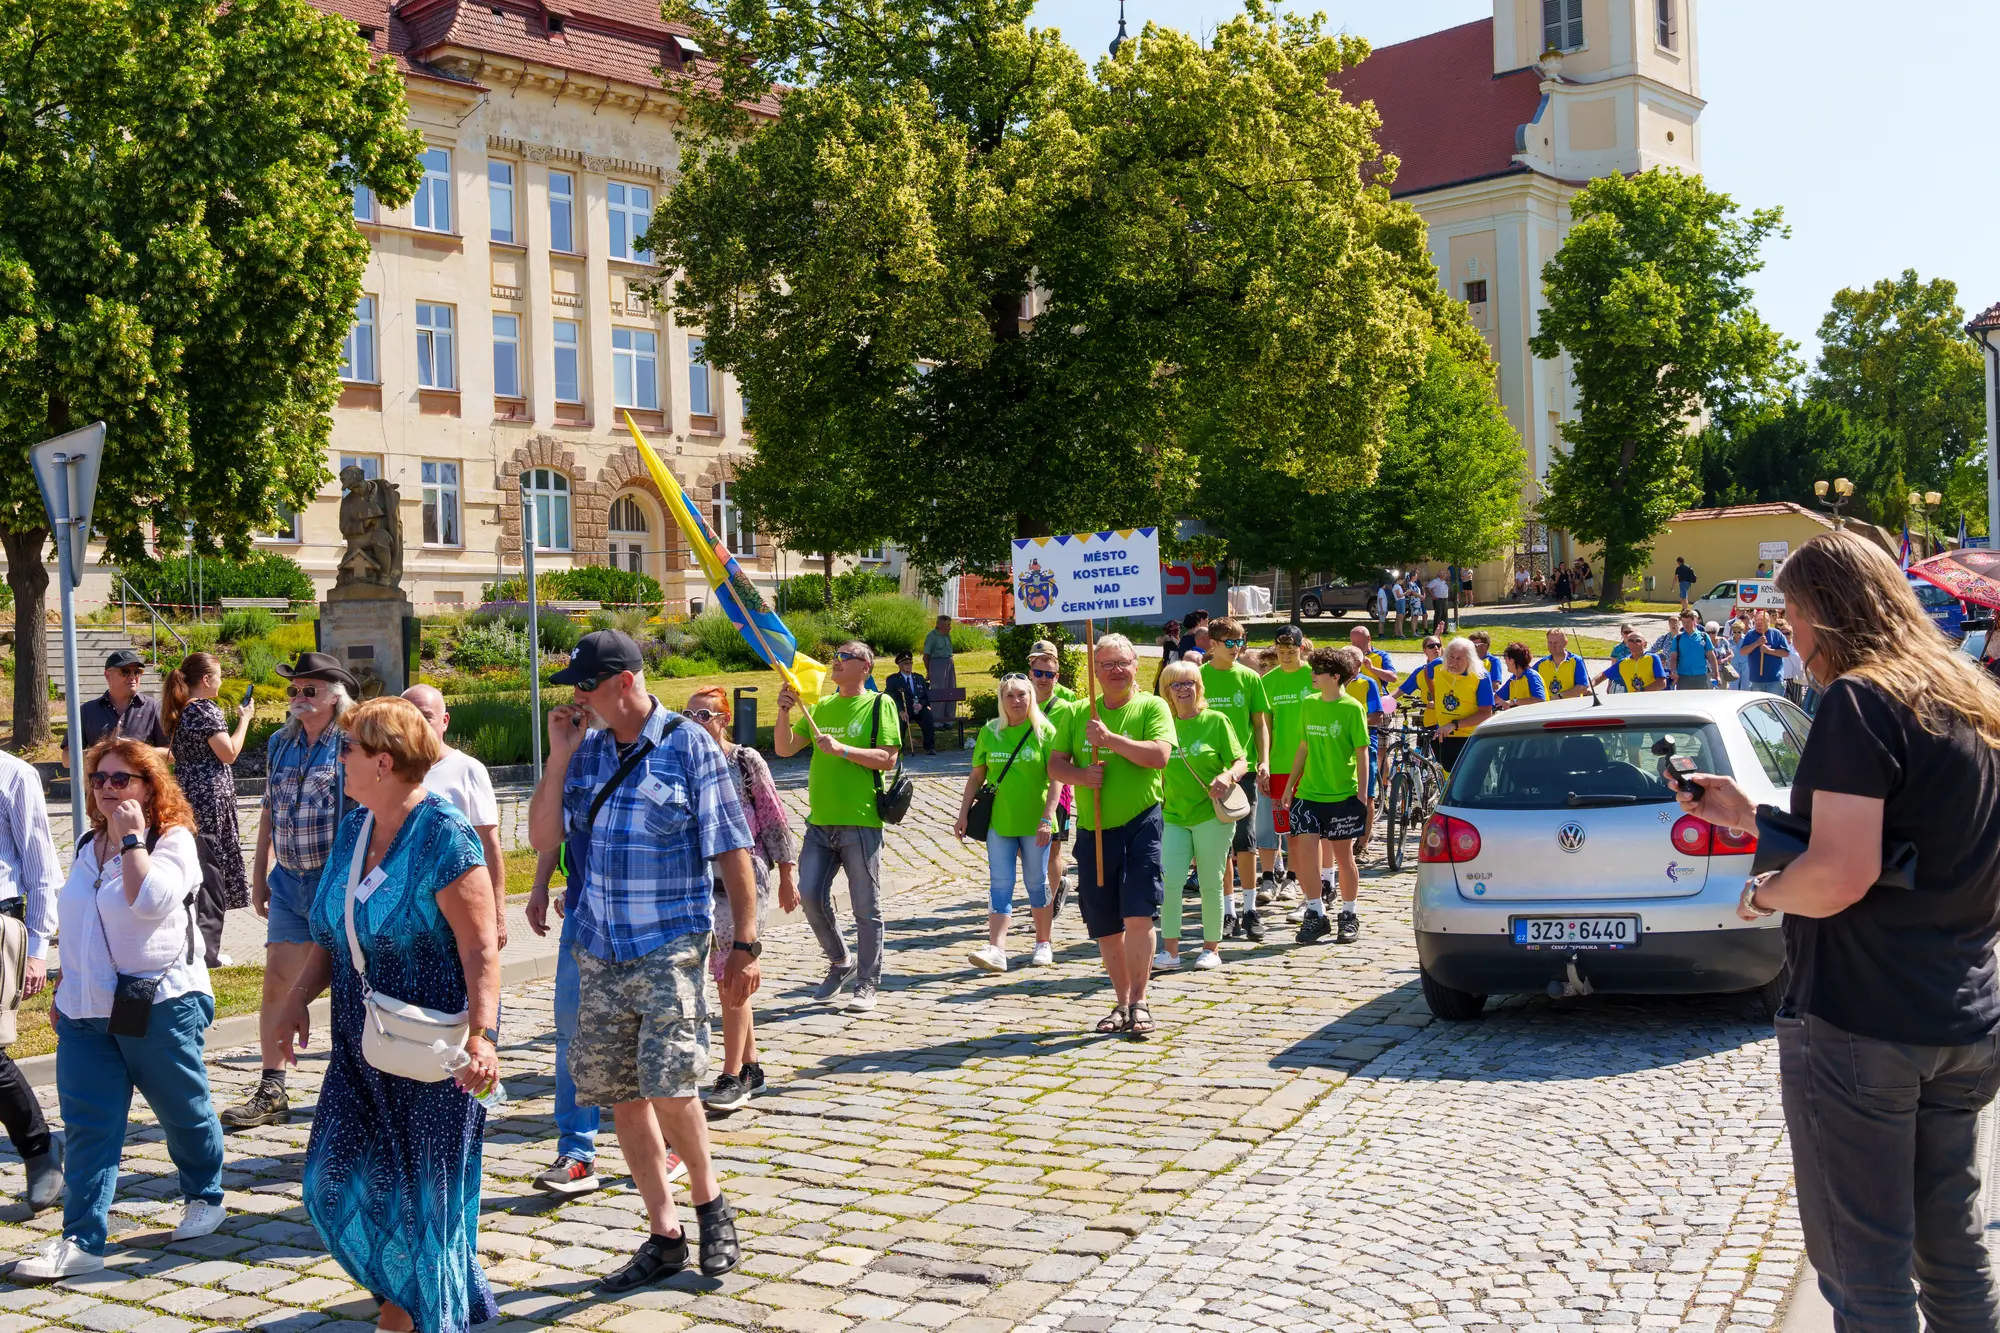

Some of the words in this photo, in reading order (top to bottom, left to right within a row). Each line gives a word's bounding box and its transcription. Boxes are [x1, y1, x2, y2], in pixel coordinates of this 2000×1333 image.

[1083, 550, 1127, 563] MĚSTO
[1073, 565, 1139, 580] KOSTELEC
[1093, 583, 1120, 594] NAD
[1061, 598, 1119, 613] ČERNÝMI
[1123, 596, 1155, 608] LESY
[1531, 922, 1564, 940] 3Z3
[1580, 921, 1626, 940] 6440
